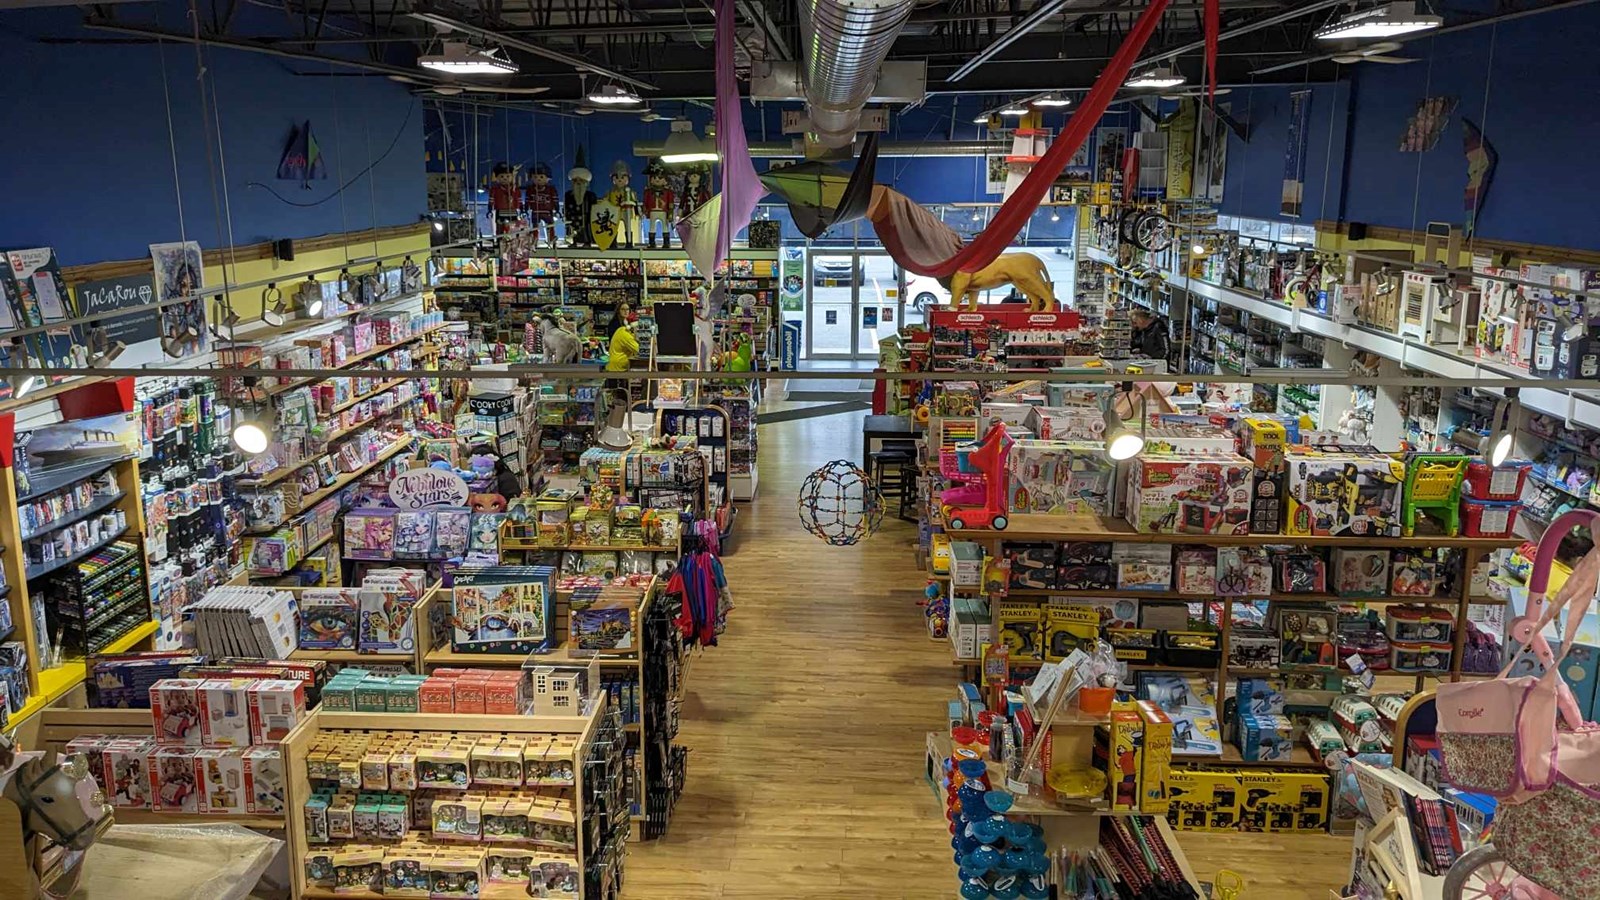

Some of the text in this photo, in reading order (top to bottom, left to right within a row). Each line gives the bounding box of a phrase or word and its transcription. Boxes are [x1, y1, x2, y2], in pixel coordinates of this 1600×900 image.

[84, 284, 137, 317] JaCaRou
[973, 337, 988, 345] siku
[784, 331, 794, 369] playmobil
[396, 473, 457, 496] Nebulous
[410, 488, 451, 509] Stars
[1000, 610, 1031, 618] STANLEY
[1053, 612, 1088, 621] STANLEY
[1117, 650, 1140, 658] STANLEY
